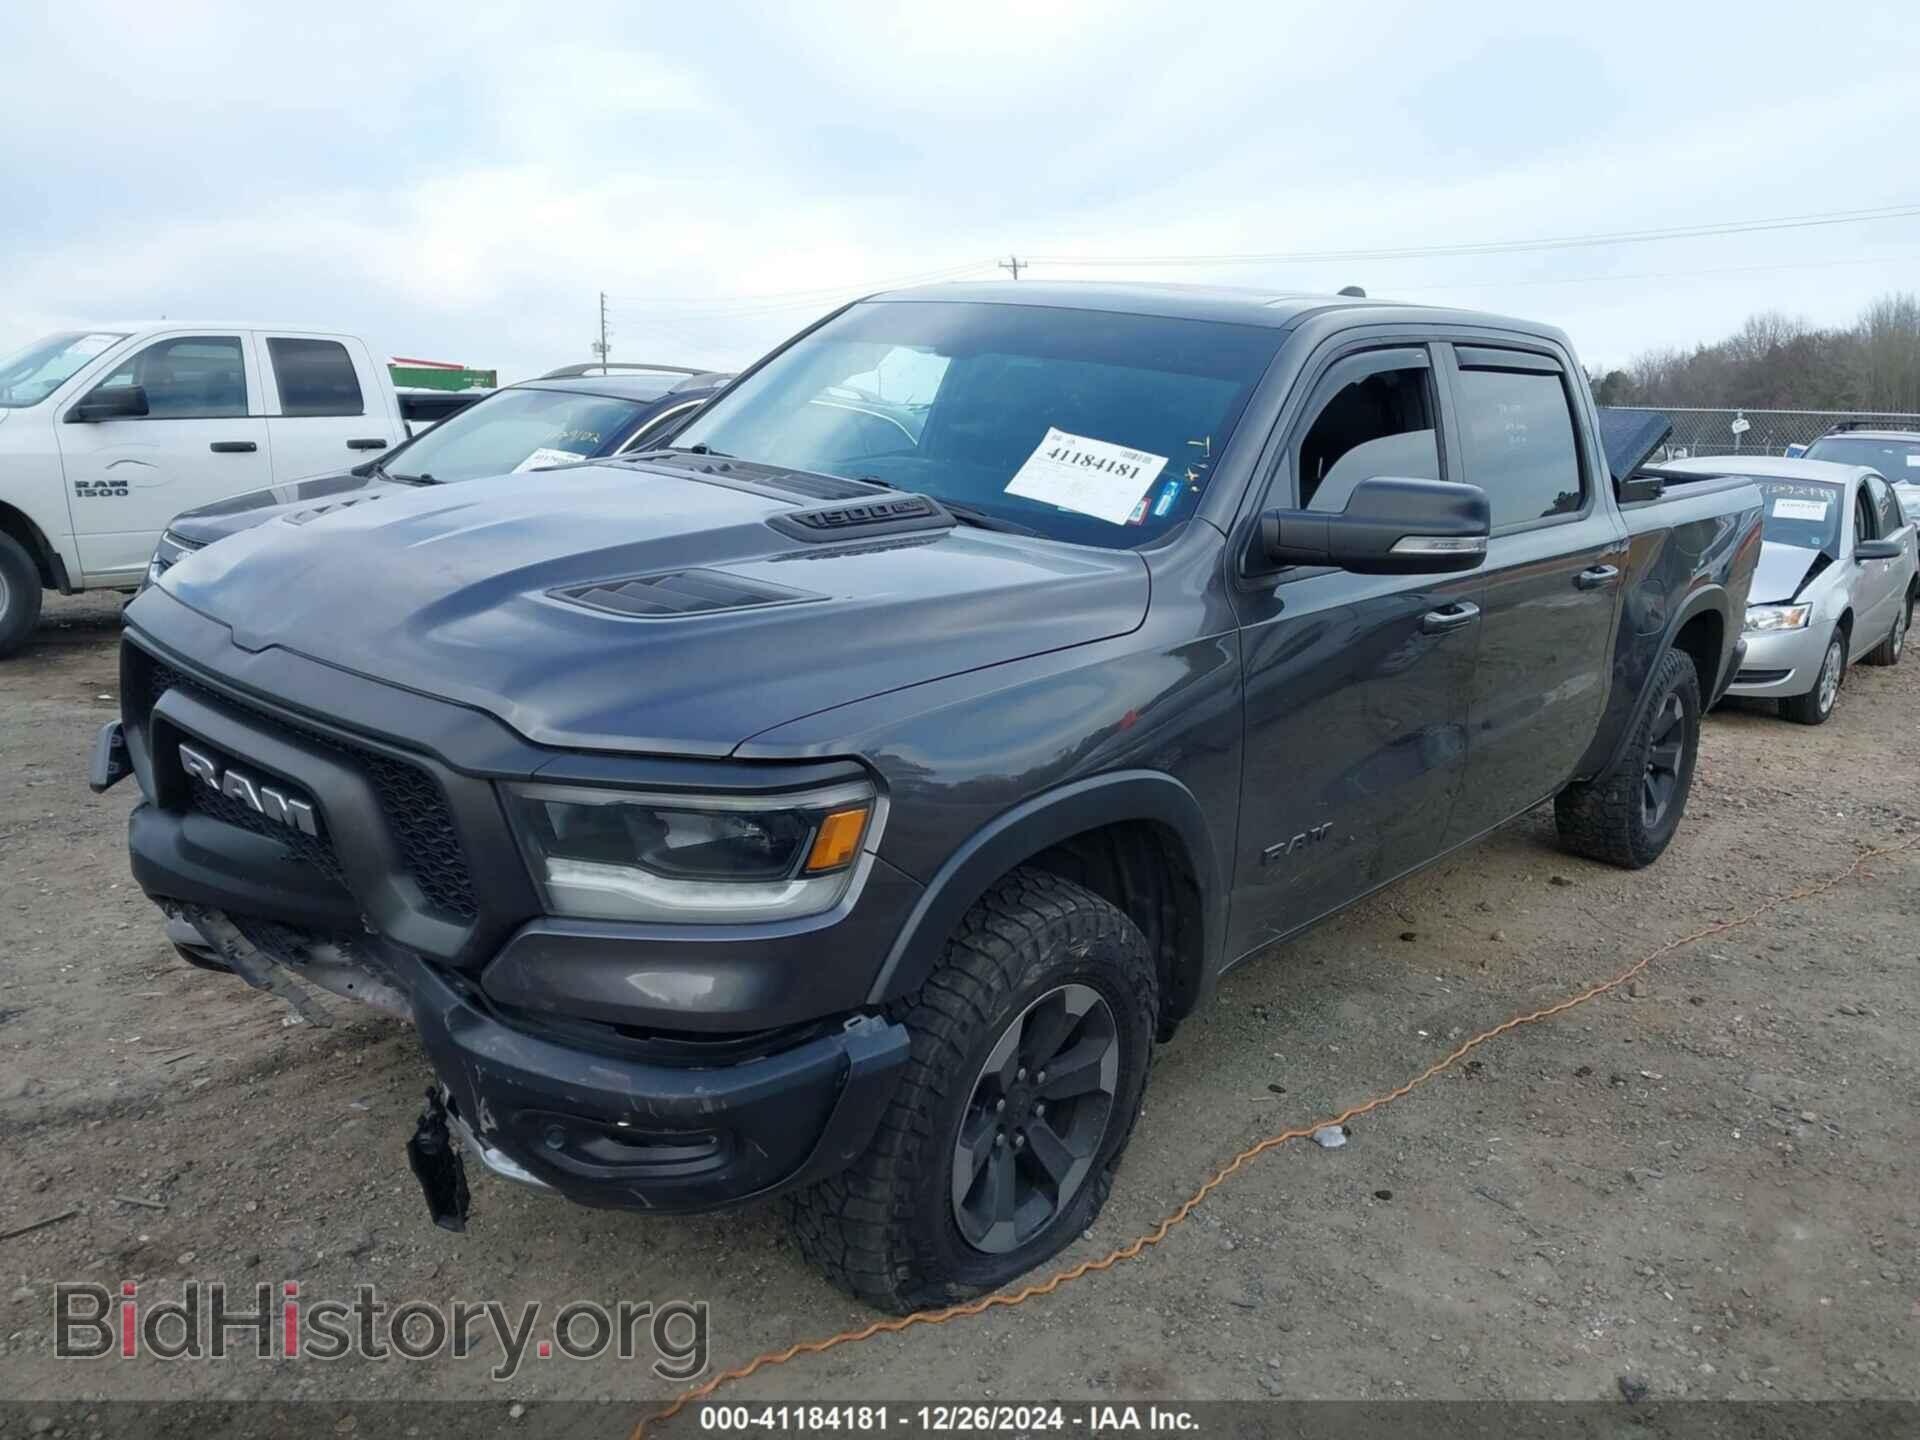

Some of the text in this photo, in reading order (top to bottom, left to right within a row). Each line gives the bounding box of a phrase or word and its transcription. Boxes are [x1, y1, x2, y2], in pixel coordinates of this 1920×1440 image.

[1047, 447, 1141, 479] 41184181
[75, 488, 128, 497] 1500
[806, 502, 895, 526] 1500
[179, 743, 317, 836] RAM
